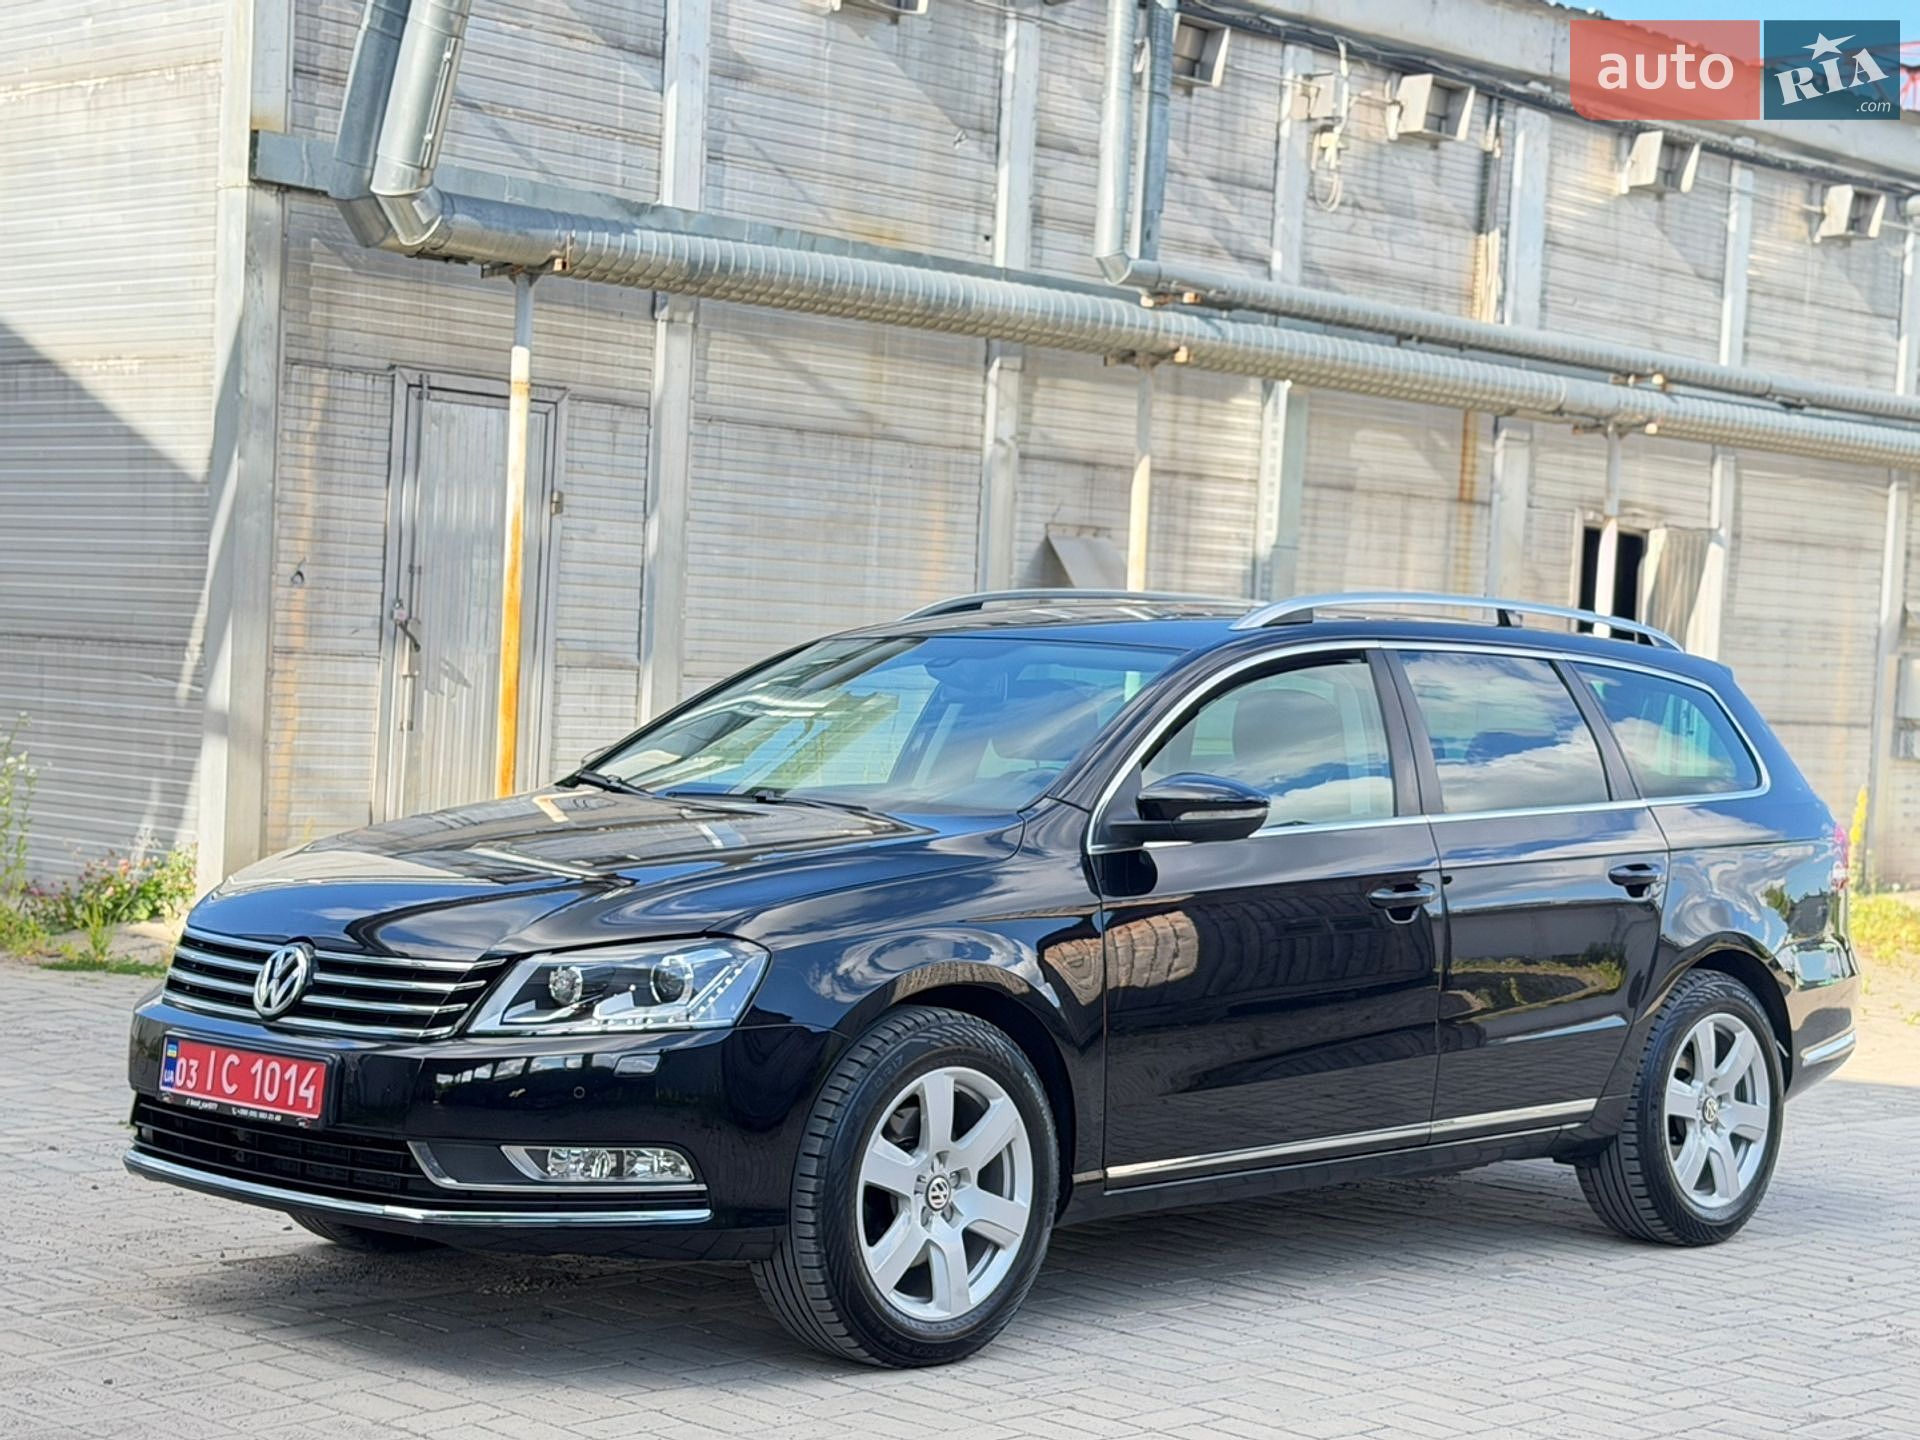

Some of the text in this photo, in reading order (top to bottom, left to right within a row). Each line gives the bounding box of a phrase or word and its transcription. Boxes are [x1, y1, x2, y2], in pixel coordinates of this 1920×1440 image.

[175, 1050, 317, 1109] 03 IC 1014
